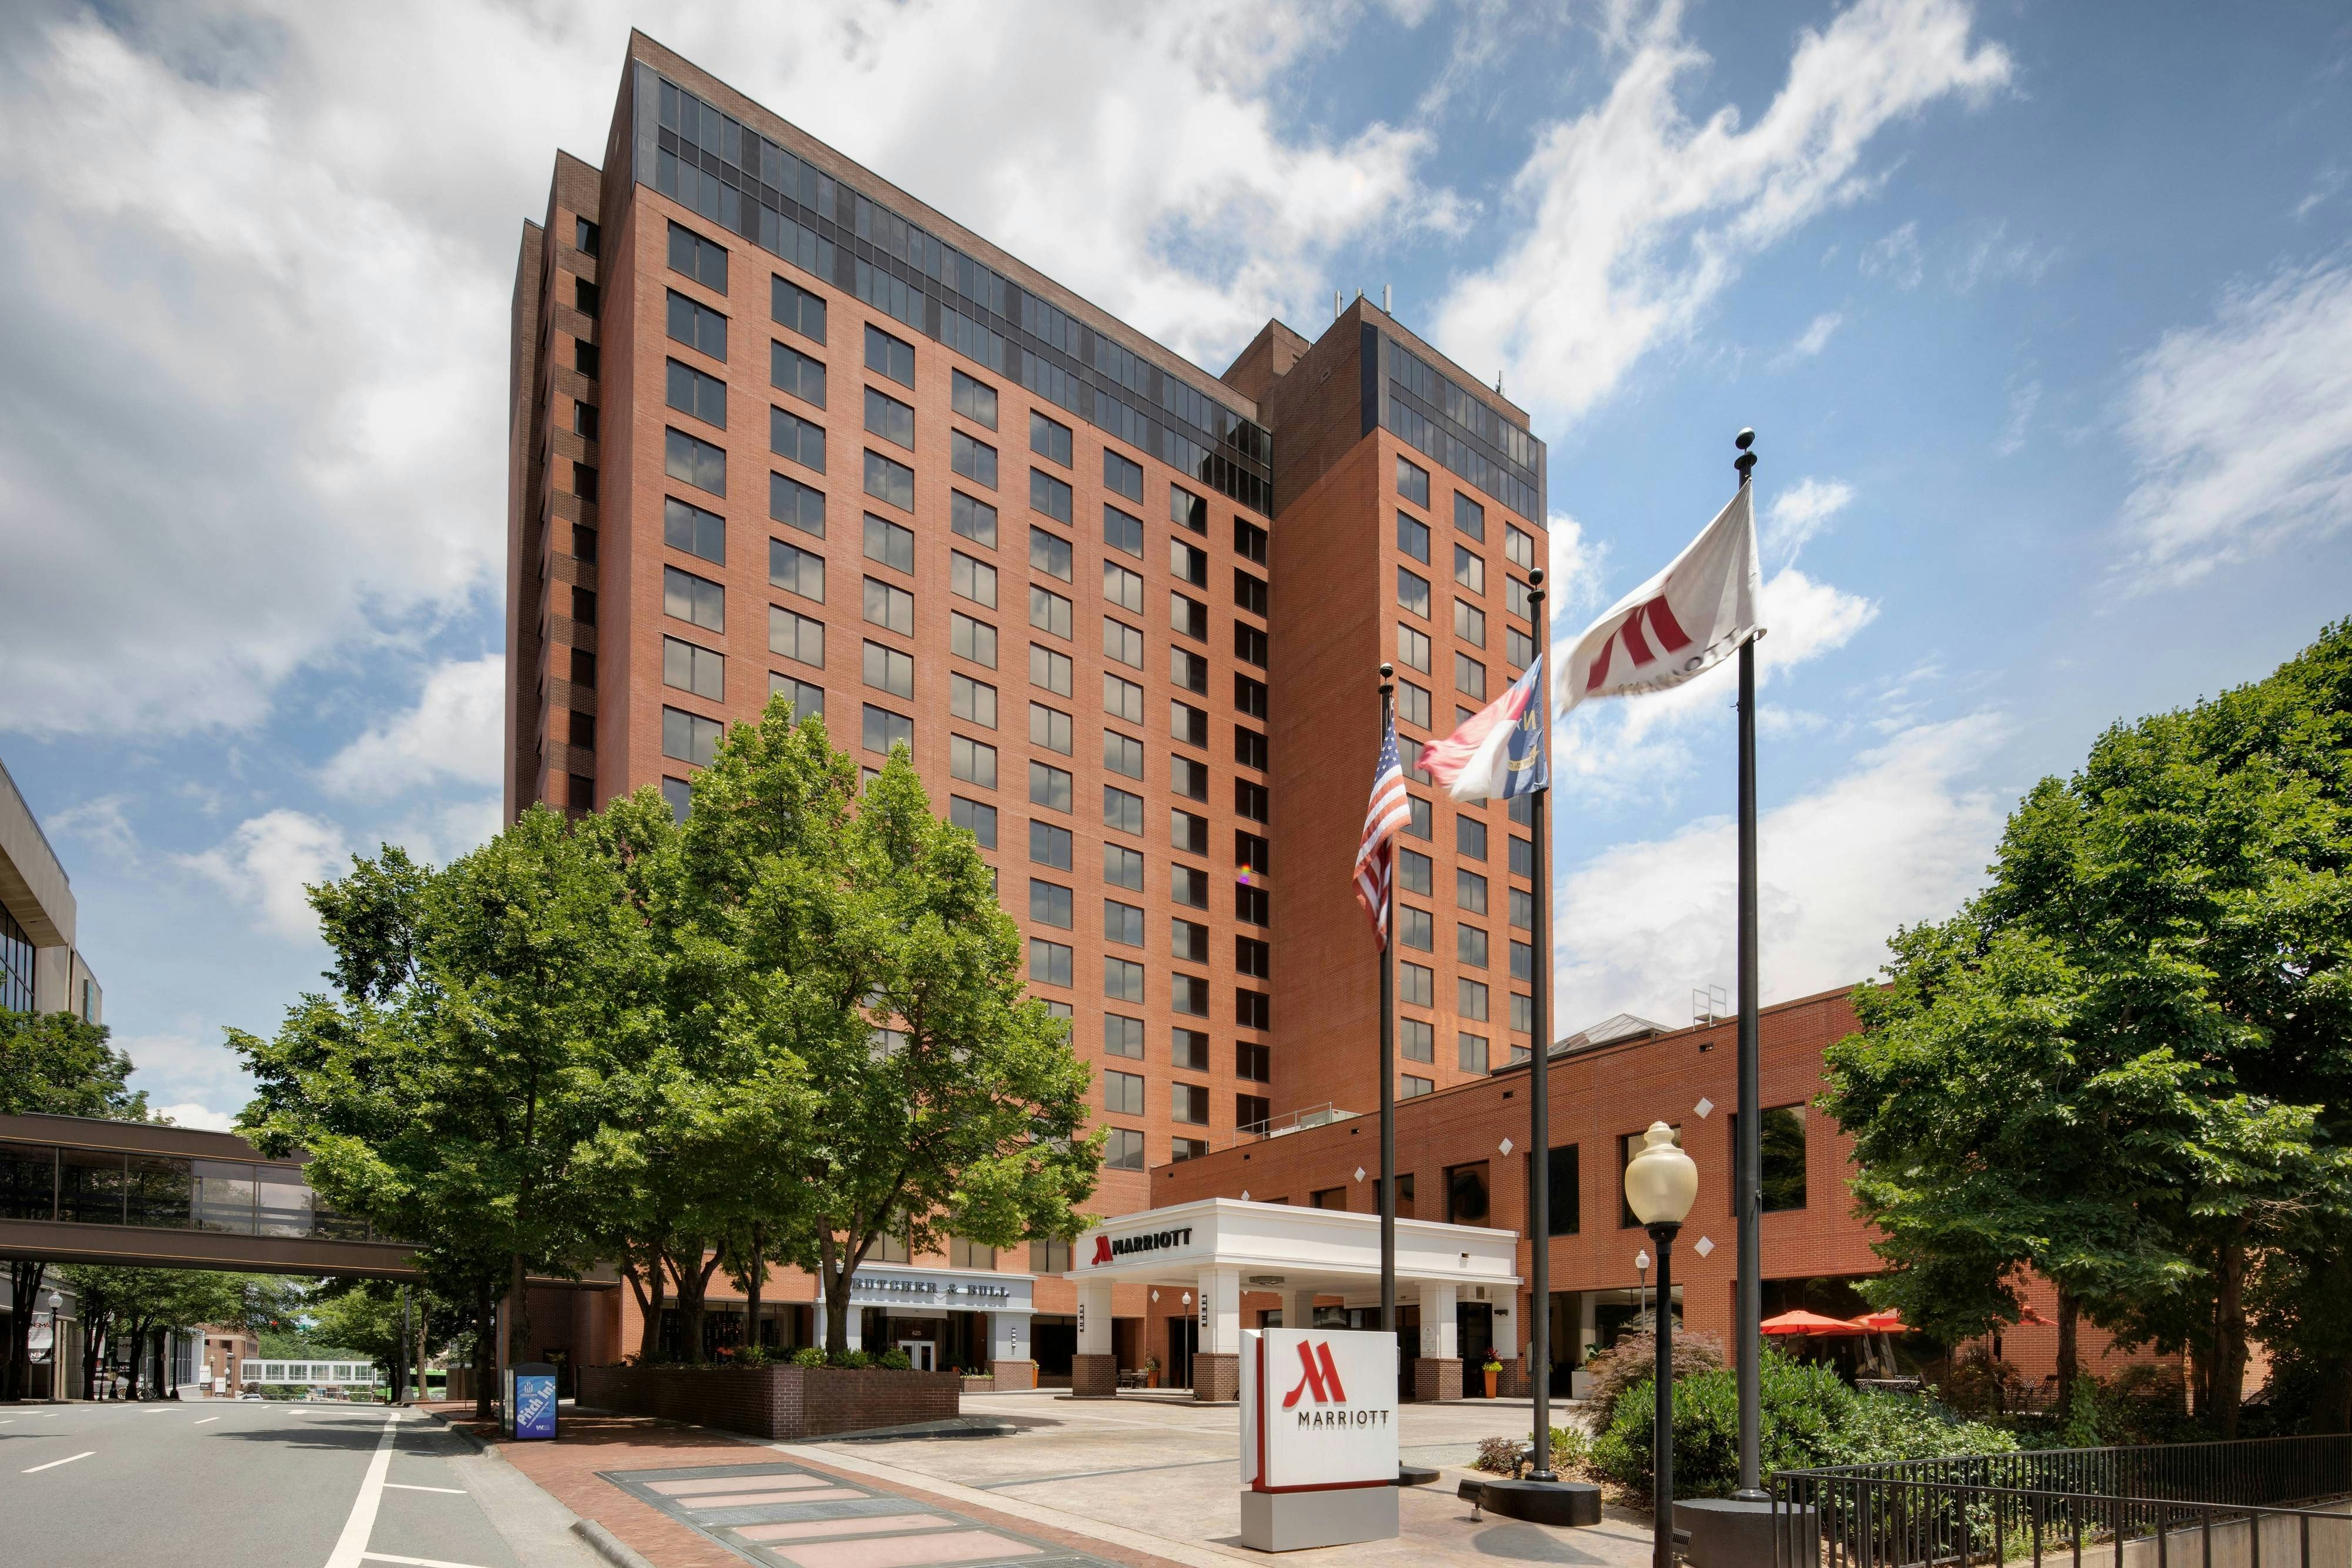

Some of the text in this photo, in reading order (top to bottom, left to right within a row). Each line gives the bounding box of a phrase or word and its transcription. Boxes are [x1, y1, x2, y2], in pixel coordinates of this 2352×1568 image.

[1112, 1228, 1192, 1255] MARRIOTT
[852, 1278, 1010, 1298] BUTCHER & BULL
[517, 1399, 544, 1426] Pitch
[537, 1380, 556, 1399] In!
[1298, 1410, 1389, 1426] MARRIOTT
